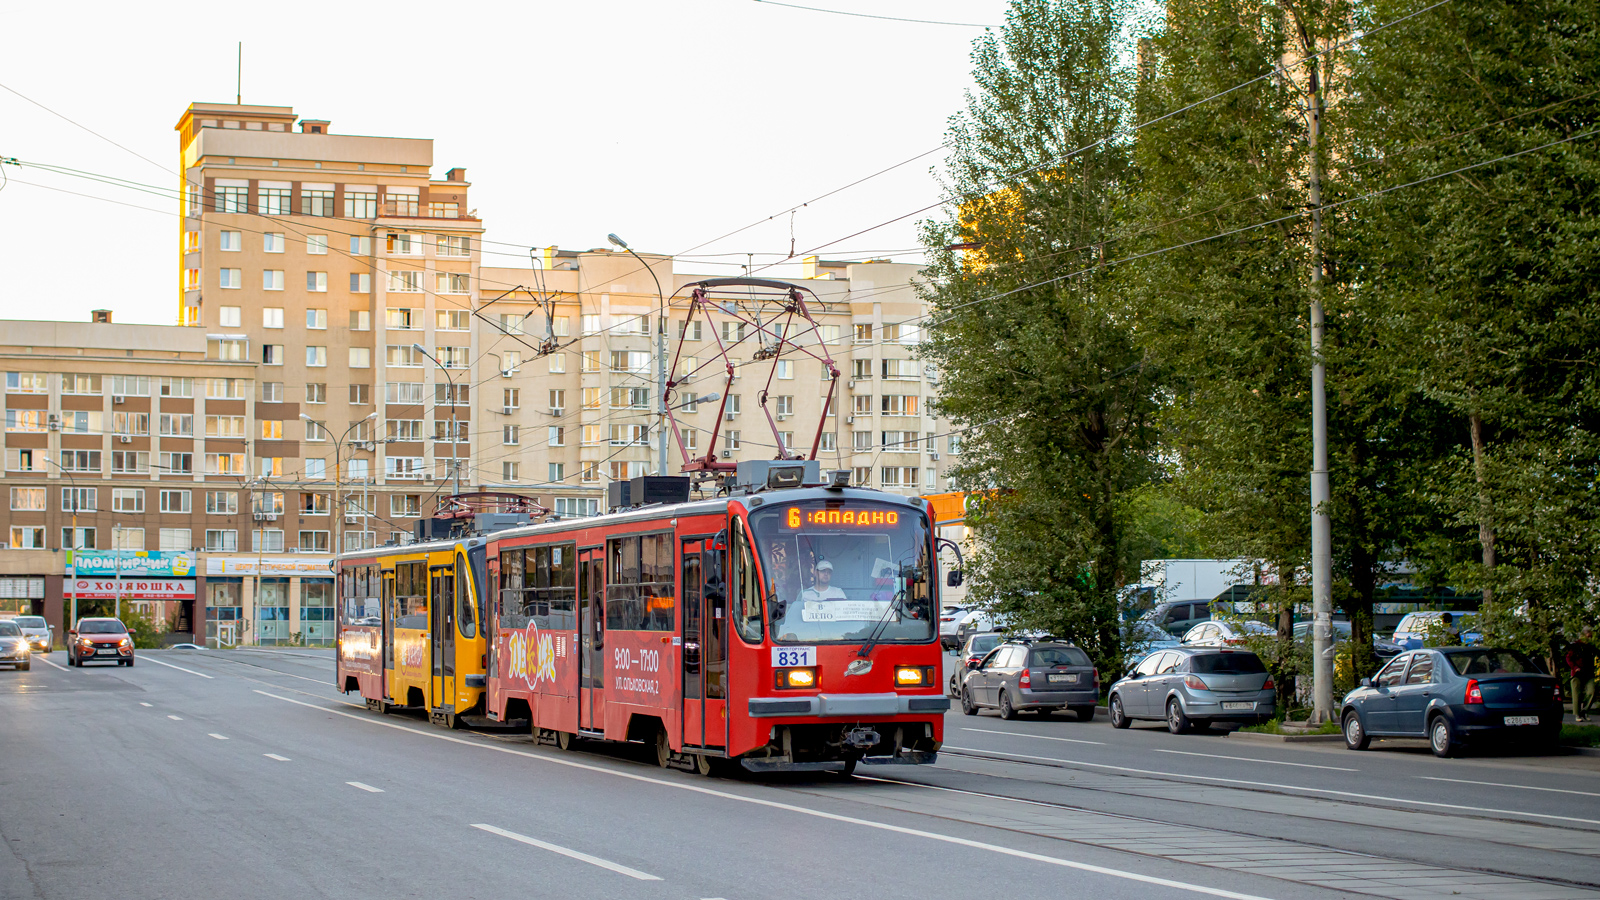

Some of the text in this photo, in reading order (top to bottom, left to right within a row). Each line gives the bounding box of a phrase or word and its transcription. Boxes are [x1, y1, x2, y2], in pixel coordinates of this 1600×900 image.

[787, 507, 800, 528] 6
[234, 563, 253, 571] ЦЕНТР
[254, 563, 296, 571] ЭТЕТИЧЕСКОЙ
[94, 582, 185, 591] ХОЗЯЮШКА
[808, 612, 833, 620] ДЕПО
[614, 647, 631, 670] 9:00
[639, 648, 659, 673] 17:00
[778, 651, 808, 666] 831
[655, 680, 659, 694] 2
